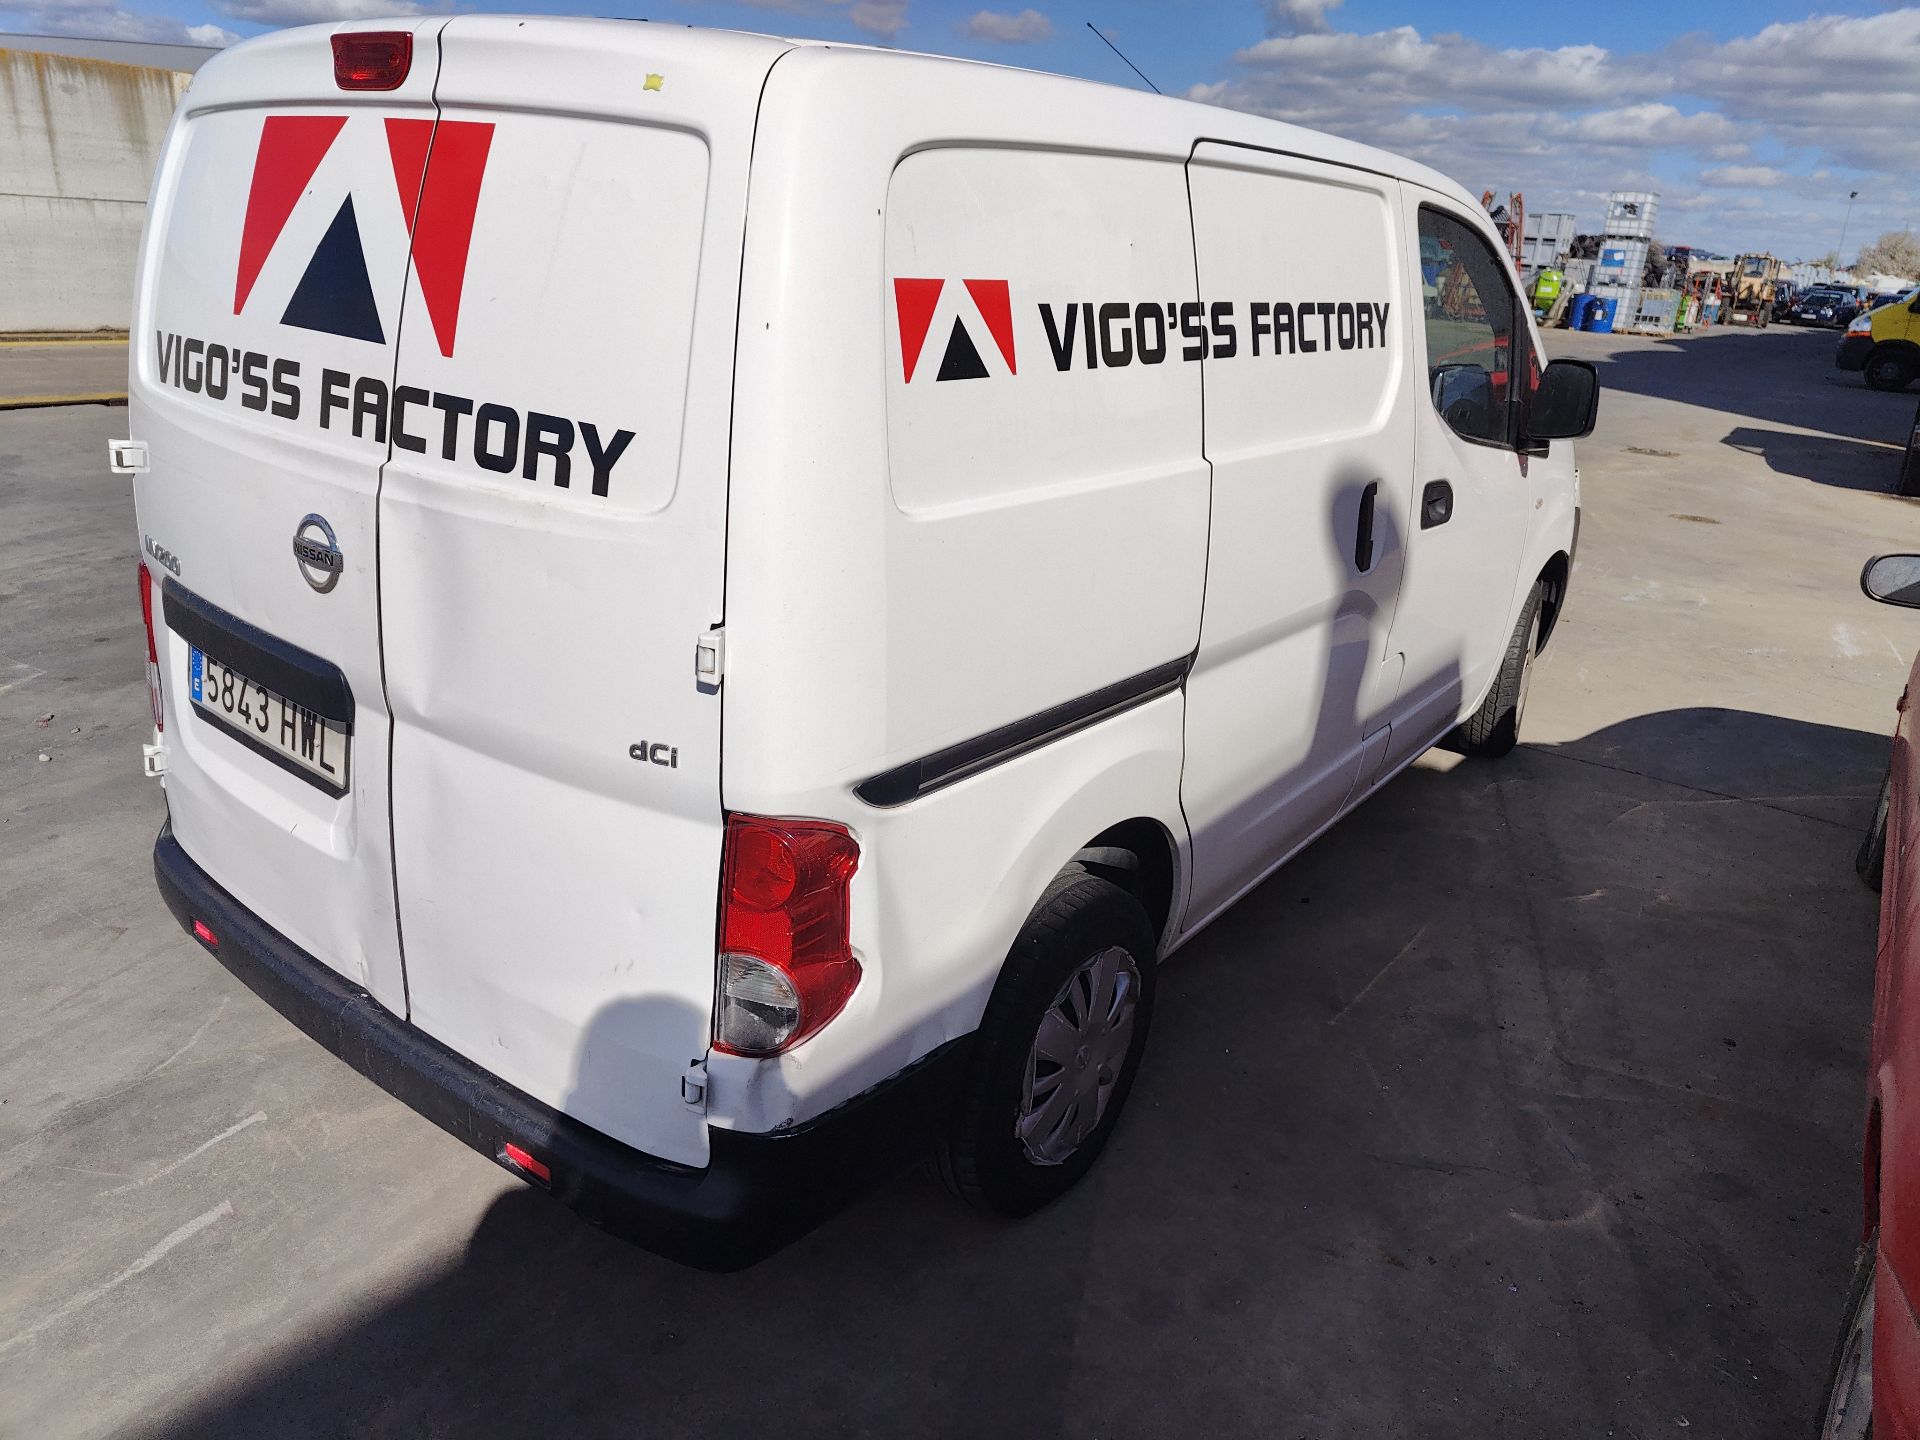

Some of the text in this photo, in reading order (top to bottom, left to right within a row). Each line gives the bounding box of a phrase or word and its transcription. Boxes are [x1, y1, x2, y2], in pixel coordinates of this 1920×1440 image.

[1038, 302, 1390, 371] VIGO'SS FACTORY
[157, 330, 637, 498] VIGO'SS FACTORY
[294, 541, 334, 567] NISSAN
[194, 655, 336, 775] E 5843 HWL
[629, 740, 678, 769] dCi
